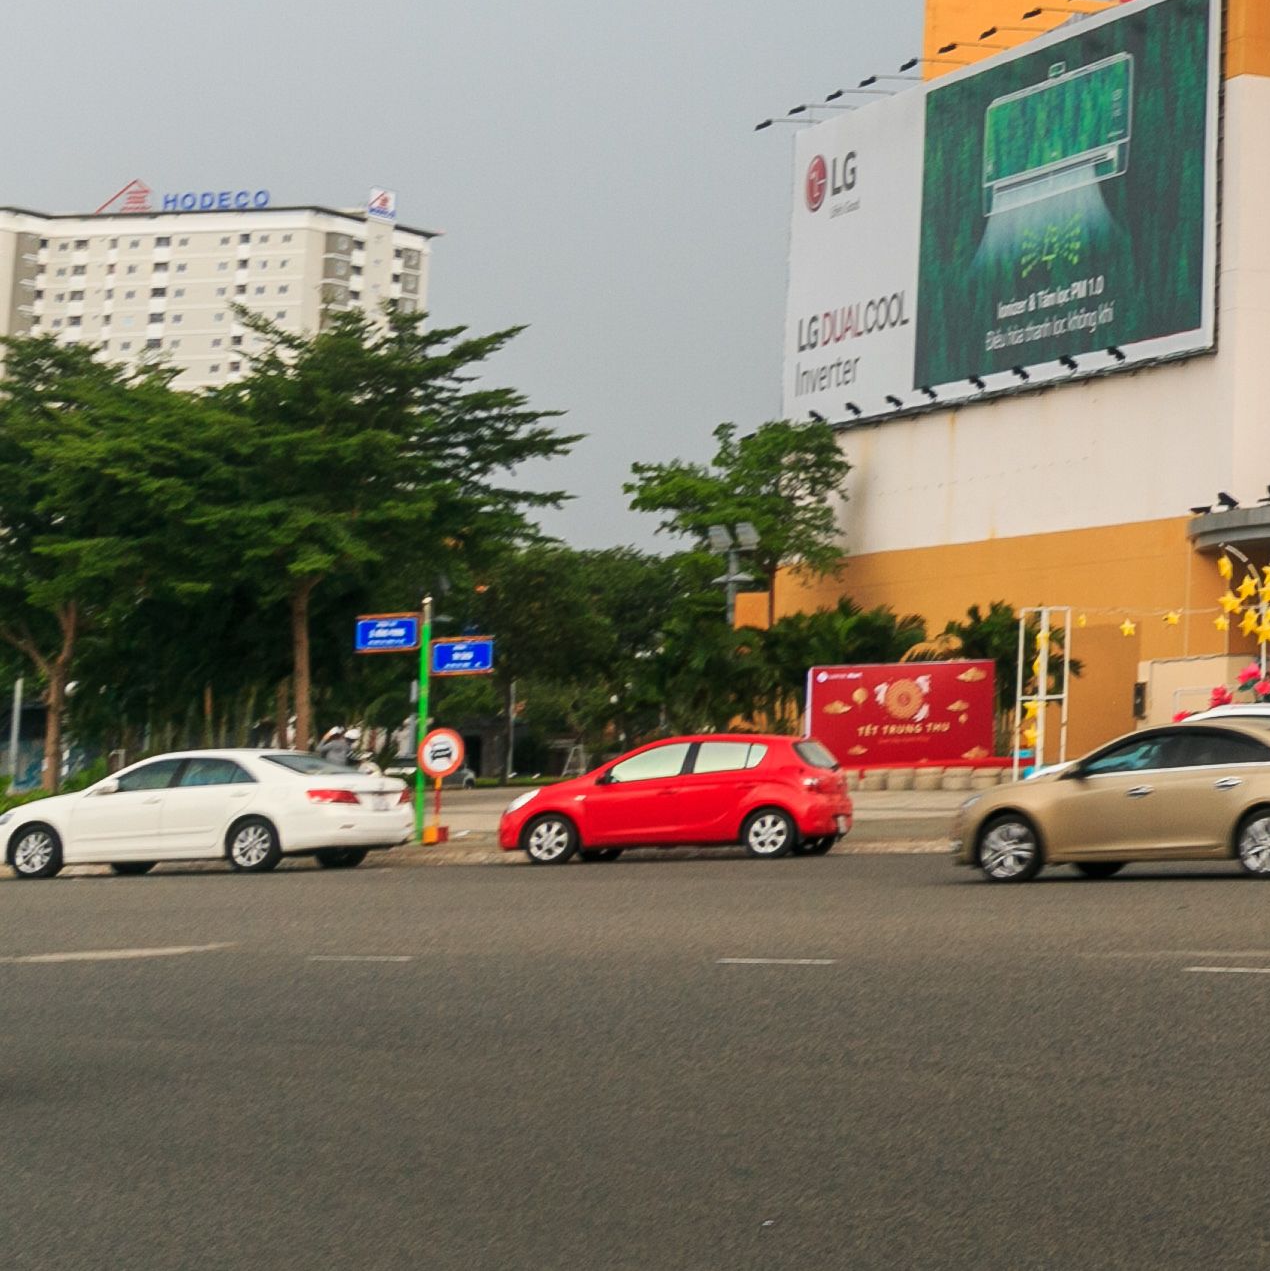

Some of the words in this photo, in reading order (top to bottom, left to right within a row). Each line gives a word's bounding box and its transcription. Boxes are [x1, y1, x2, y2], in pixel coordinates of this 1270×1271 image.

[831, 151, 857, 196] LG
[163, 189, 270, 211] HODECO
[797, 314, 819, 353] LG
[821, 290, 910, 348] DUALCOOL
[795, 356, 861, 398] Inverter
[857, 721, 878, 737] TẾT
[882, 722, 922, 736] TRUNG
[925, 721, 950, 734] THU
